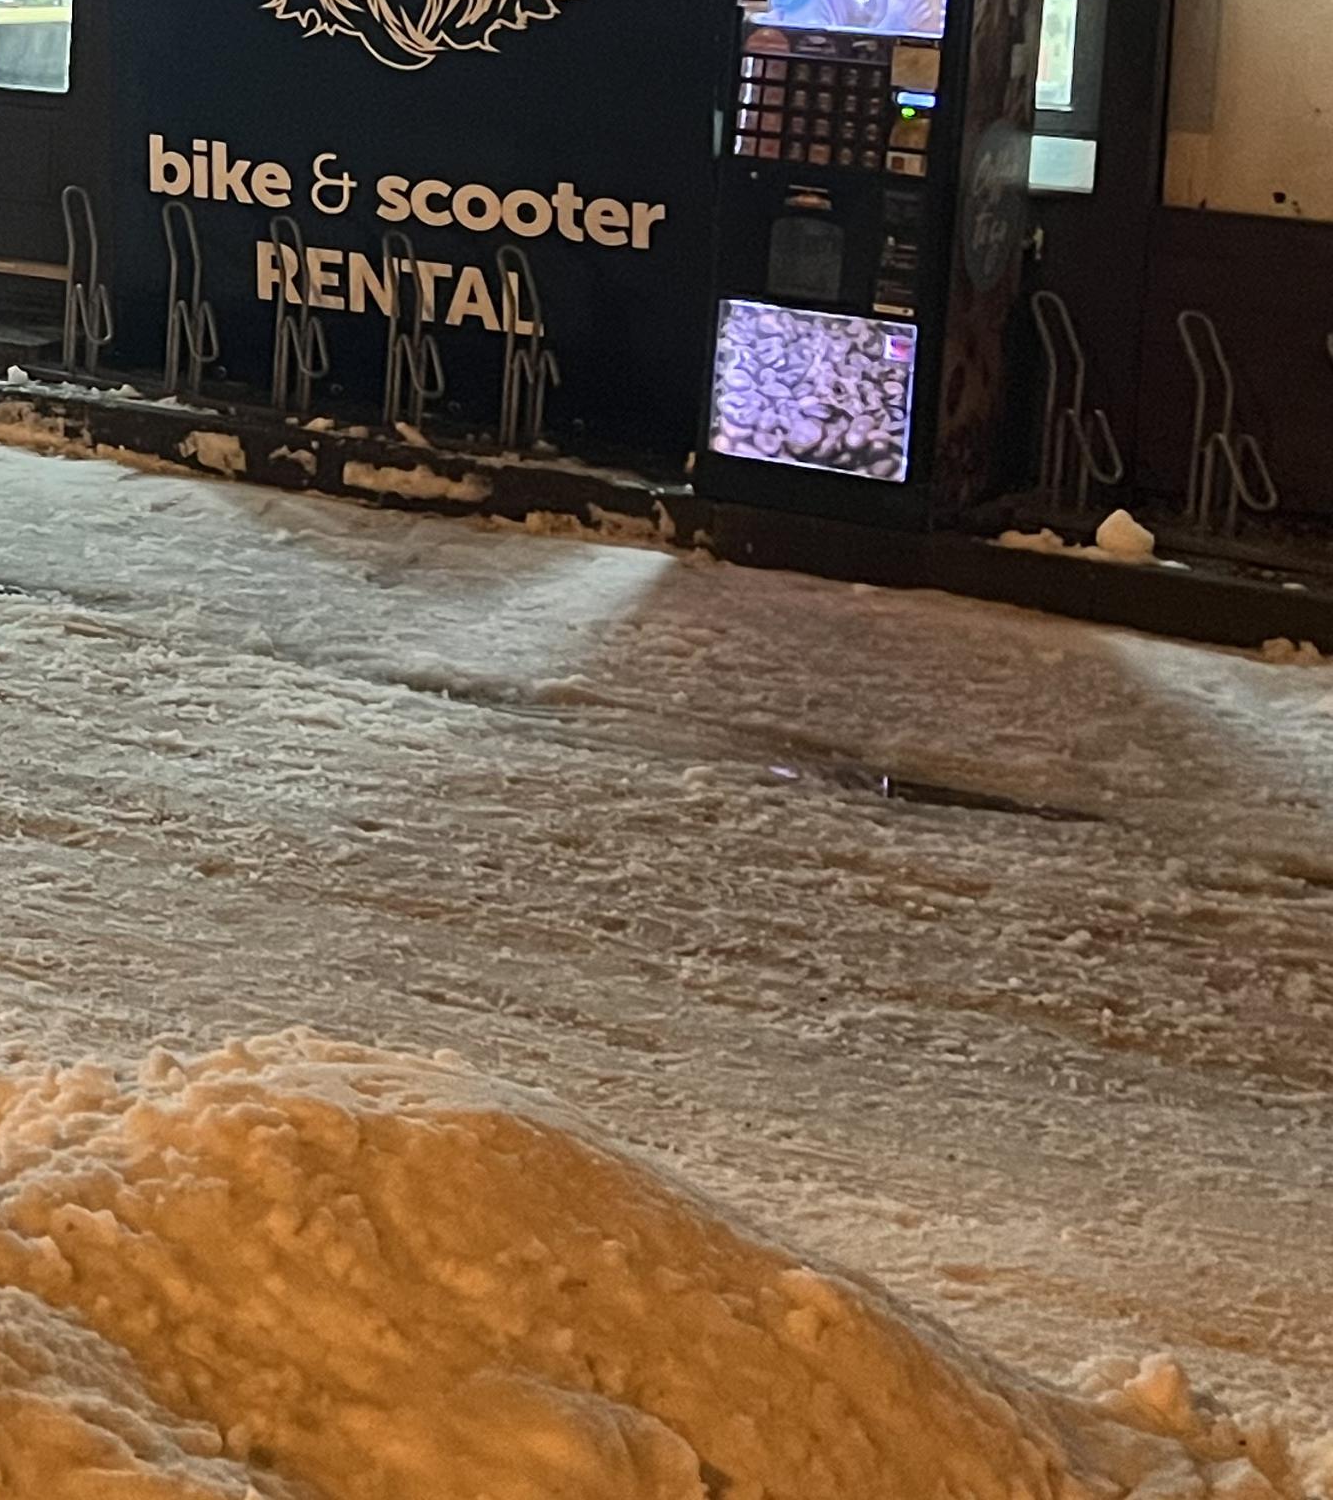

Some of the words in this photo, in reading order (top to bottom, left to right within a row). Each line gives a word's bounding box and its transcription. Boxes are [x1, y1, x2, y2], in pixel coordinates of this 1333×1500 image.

[148, 133, 293, 208] bike
[310, 152, 358, 215] &
[375, 174, 666, 250] scooter
[255, 240, 545, 338] RENTAL
